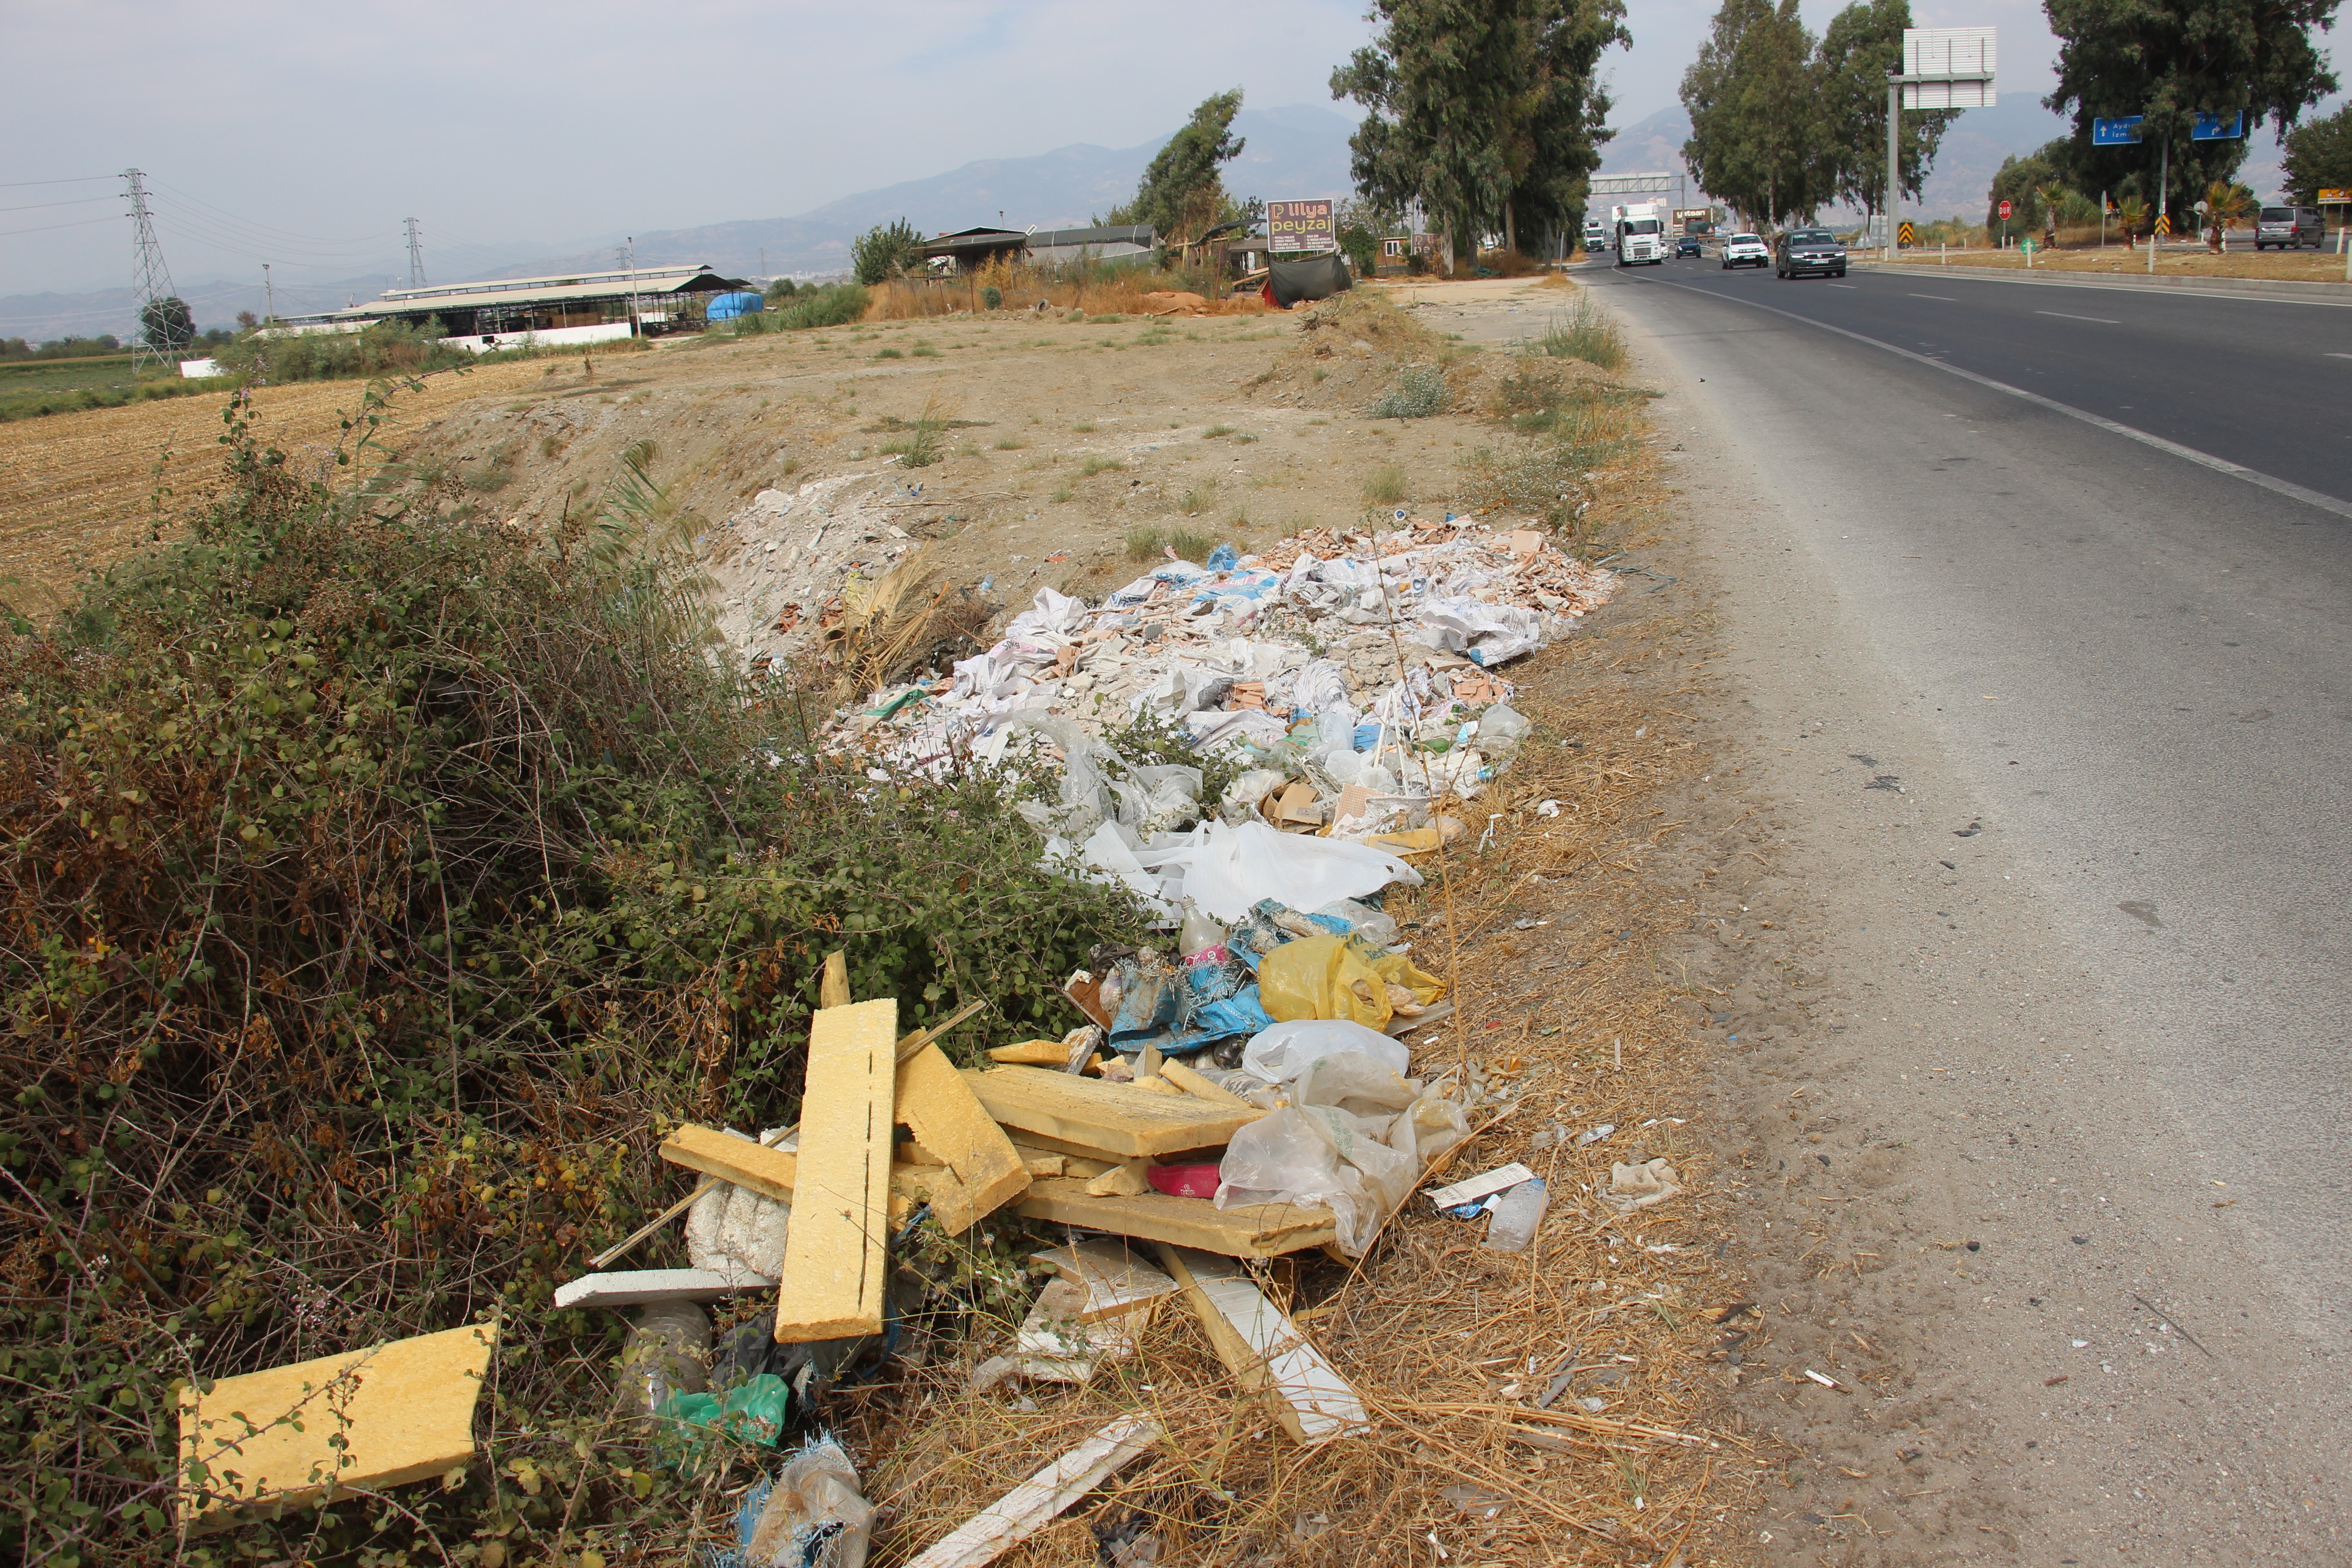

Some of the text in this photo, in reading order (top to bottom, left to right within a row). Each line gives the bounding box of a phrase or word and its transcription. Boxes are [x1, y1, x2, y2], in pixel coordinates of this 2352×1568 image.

[1289, 202, 1328, 219] lilya
[1271, 216, 1331, 235] peyzaj
[1001, 639, 1020, 651] 50kg
